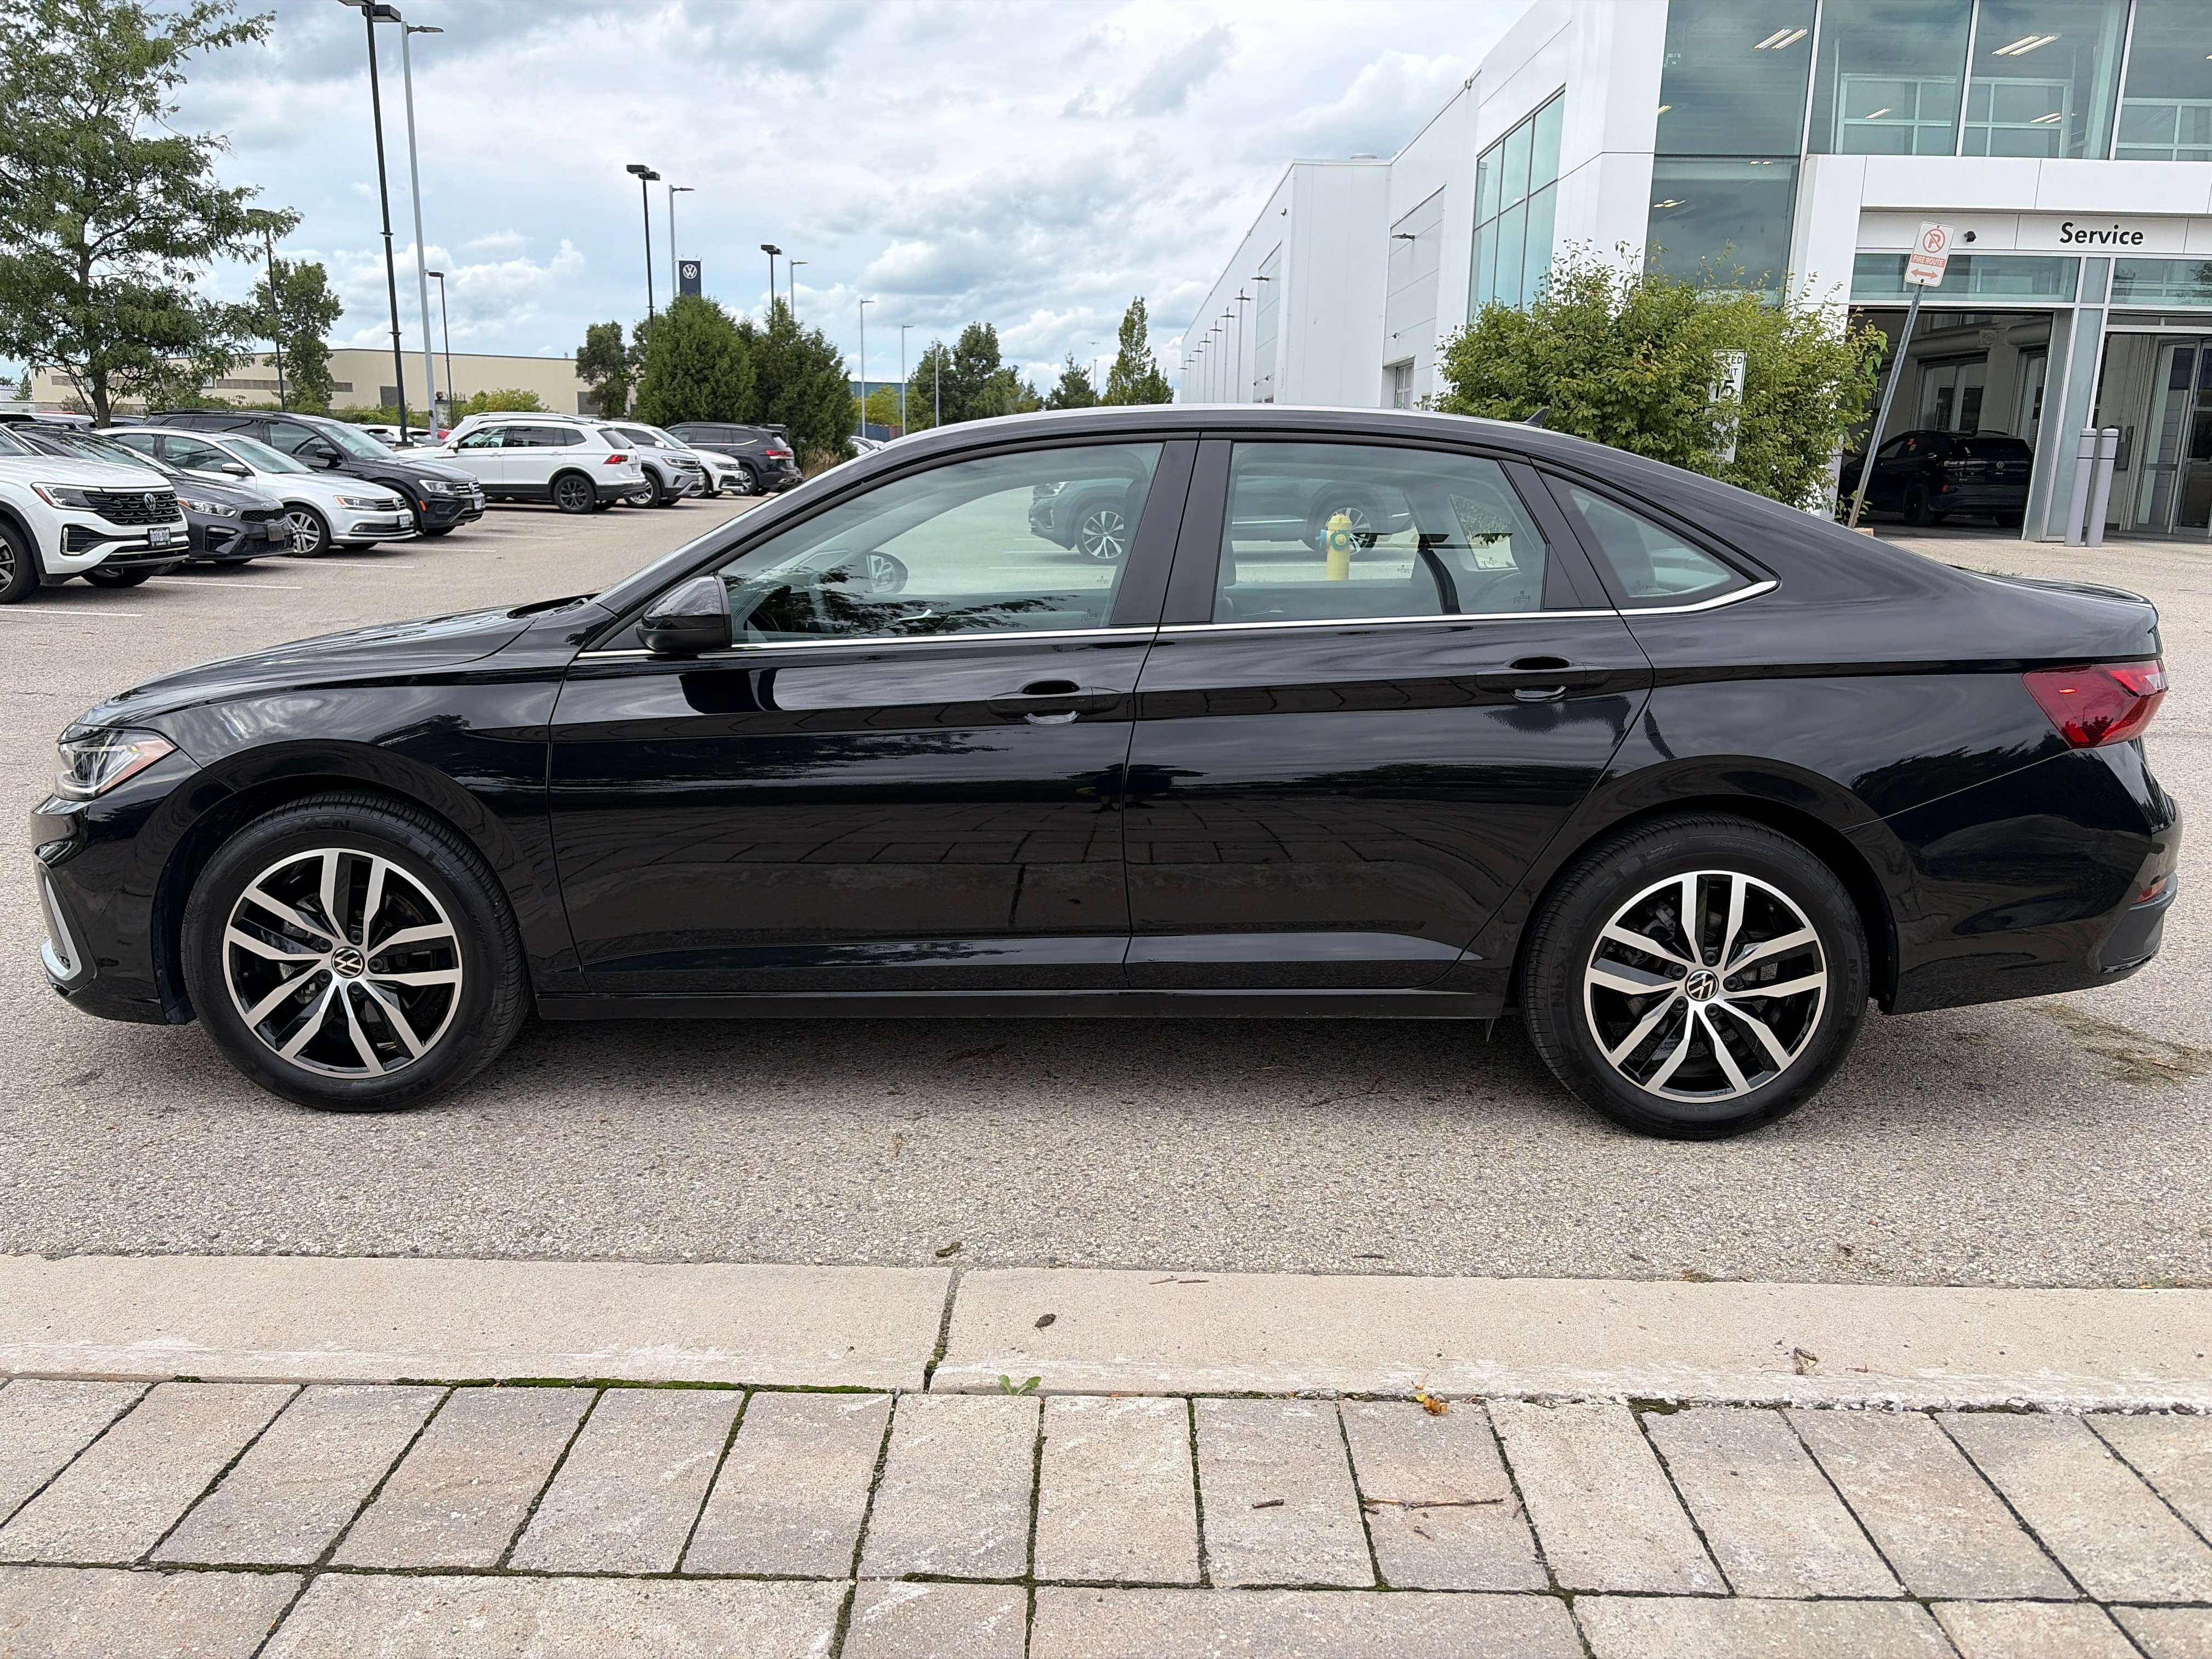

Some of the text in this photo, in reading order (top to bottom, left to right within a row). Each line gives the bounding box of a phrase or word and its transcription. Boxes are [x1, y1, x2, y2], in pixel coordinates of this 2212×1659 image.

[2059, 222, 2143, 245] Service
[1912, 255, 1944, 266] FIRE ROUTE
